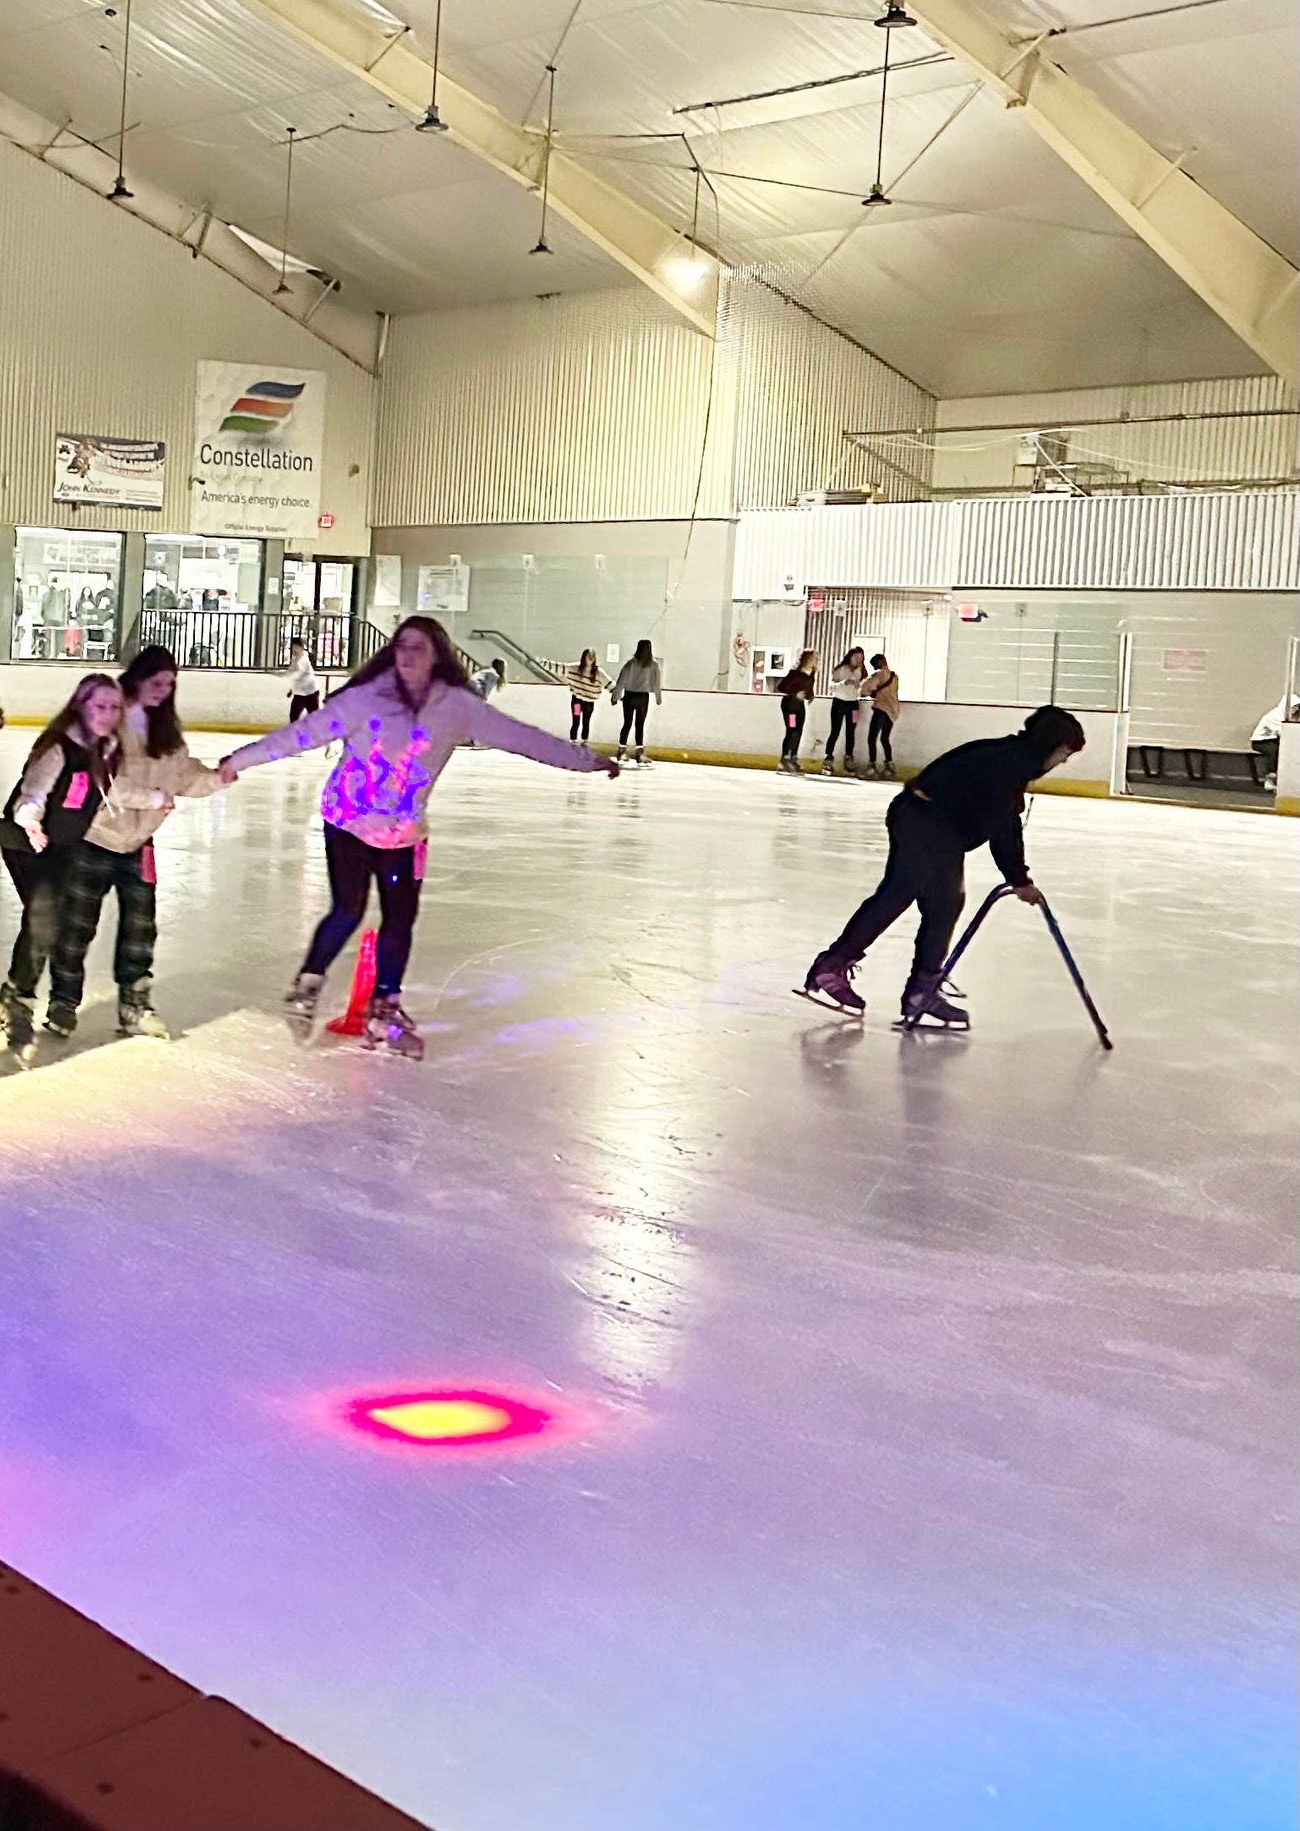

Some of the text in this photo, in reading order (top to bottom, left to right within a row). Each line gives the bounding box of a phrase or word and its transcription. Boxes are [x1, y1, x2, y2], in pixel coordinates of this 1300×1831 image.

[200, 444, 313, 472] Constellation
[57, 482, 121, 495] JOHN KENNEDY
[201, 490, 247, 504] America's
[248, 495, 280, 508] energy
